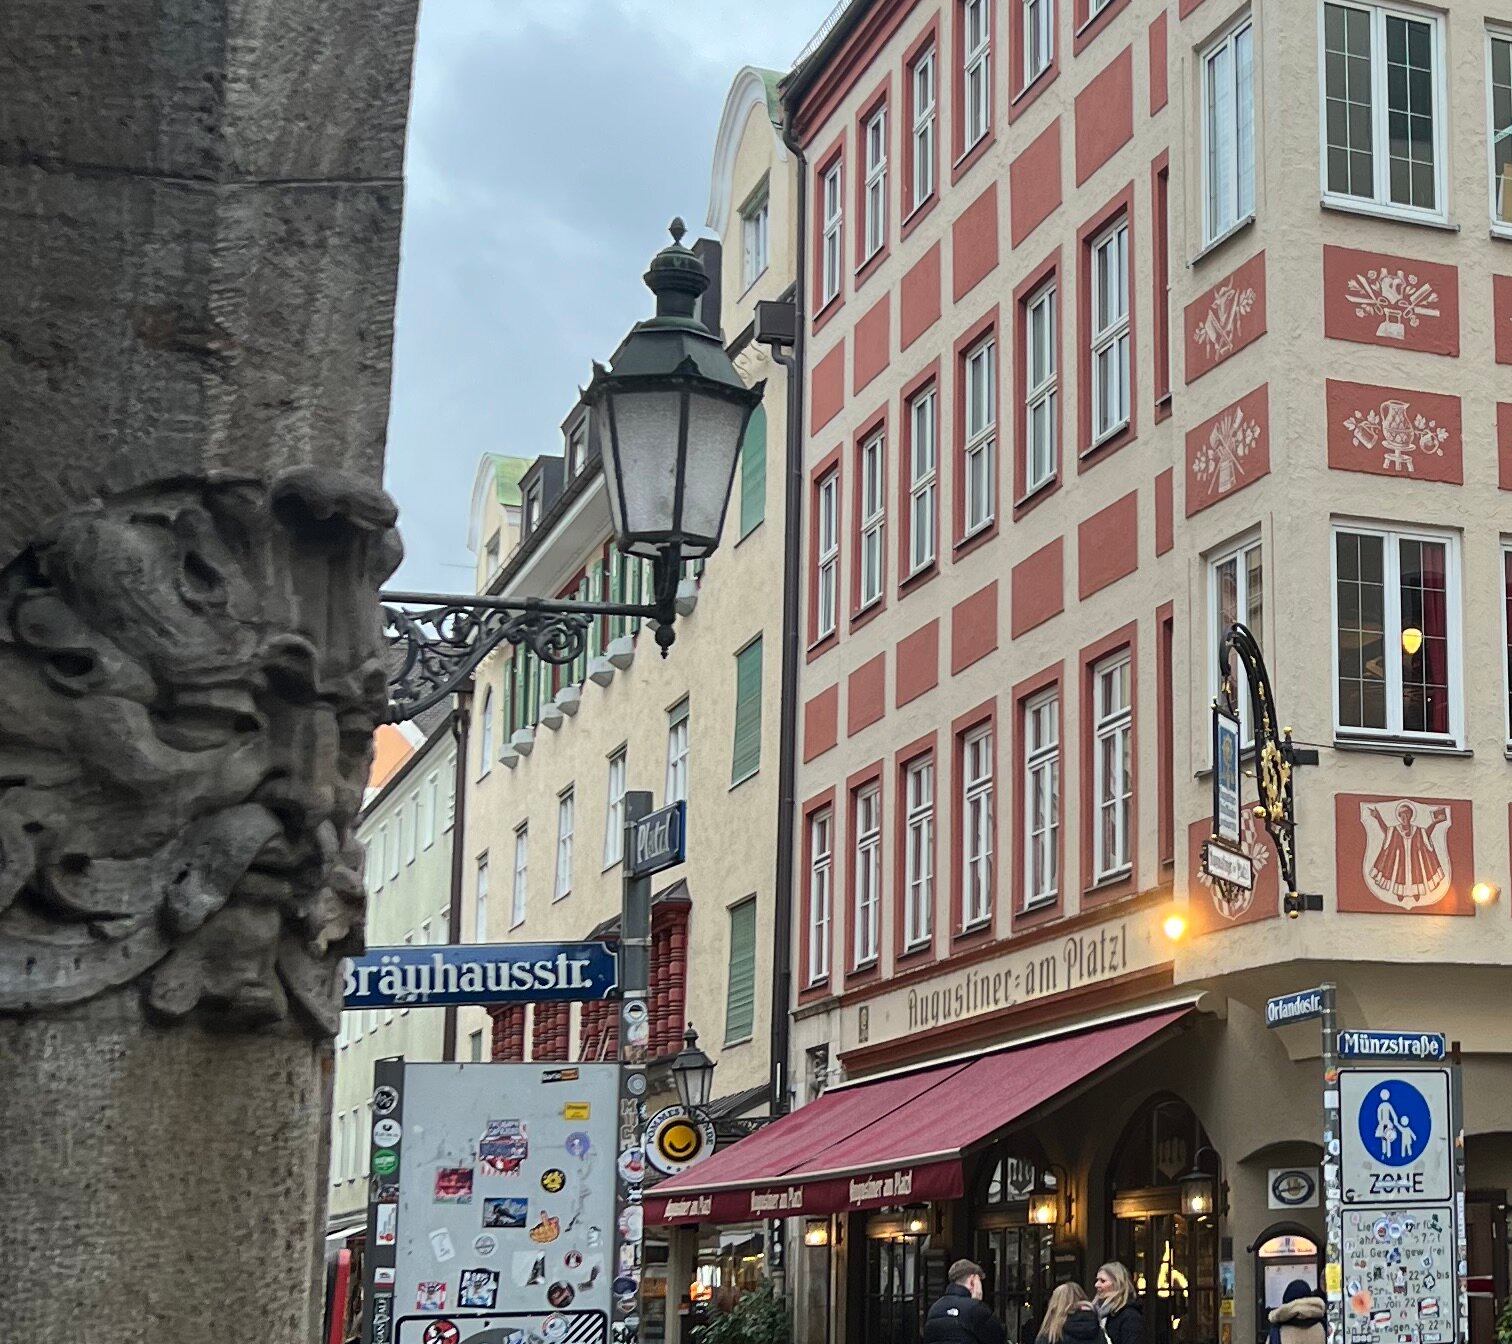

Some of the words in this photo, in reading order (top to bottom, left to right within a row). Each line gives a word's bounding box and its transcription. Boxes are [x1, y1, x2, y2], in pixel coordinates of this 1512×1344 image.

[637, 811, 671, 864] Platzl
[1063, 923, 1128, 990] Platzl
[1266, 994, 1323, 1022] Orlandostr.
[1343, 1033, 1439, 1058] Münzstraße
[1369, 1172, 1424, 1194] ZONE
